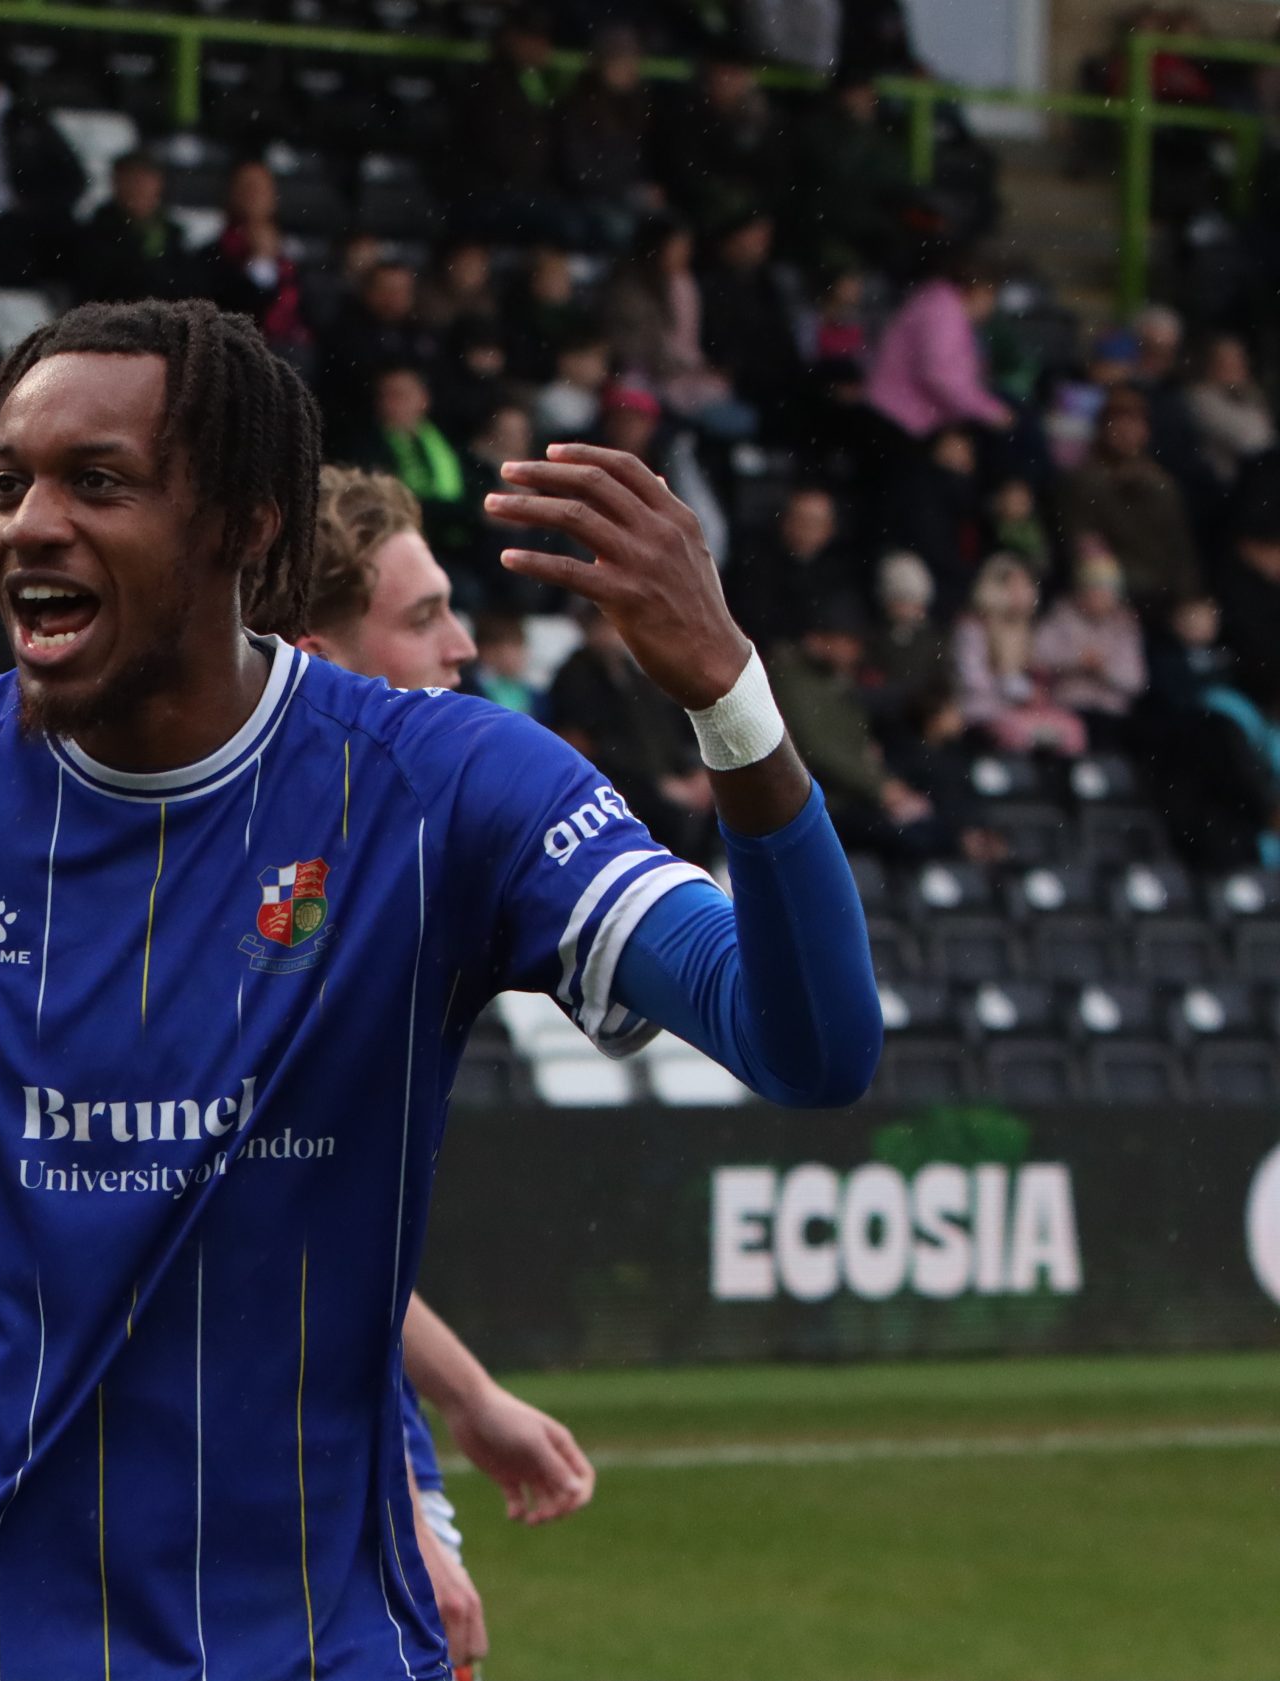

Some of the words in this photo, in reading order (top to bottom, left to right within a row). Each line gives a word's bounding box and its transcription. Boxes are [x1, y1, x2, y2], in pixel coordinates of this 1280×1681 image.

[22, 1075, 258, 1142] Brunel
[19, 1159, 193, 1200] University
[711, 1161, 1083, 1301] ECOSIA
